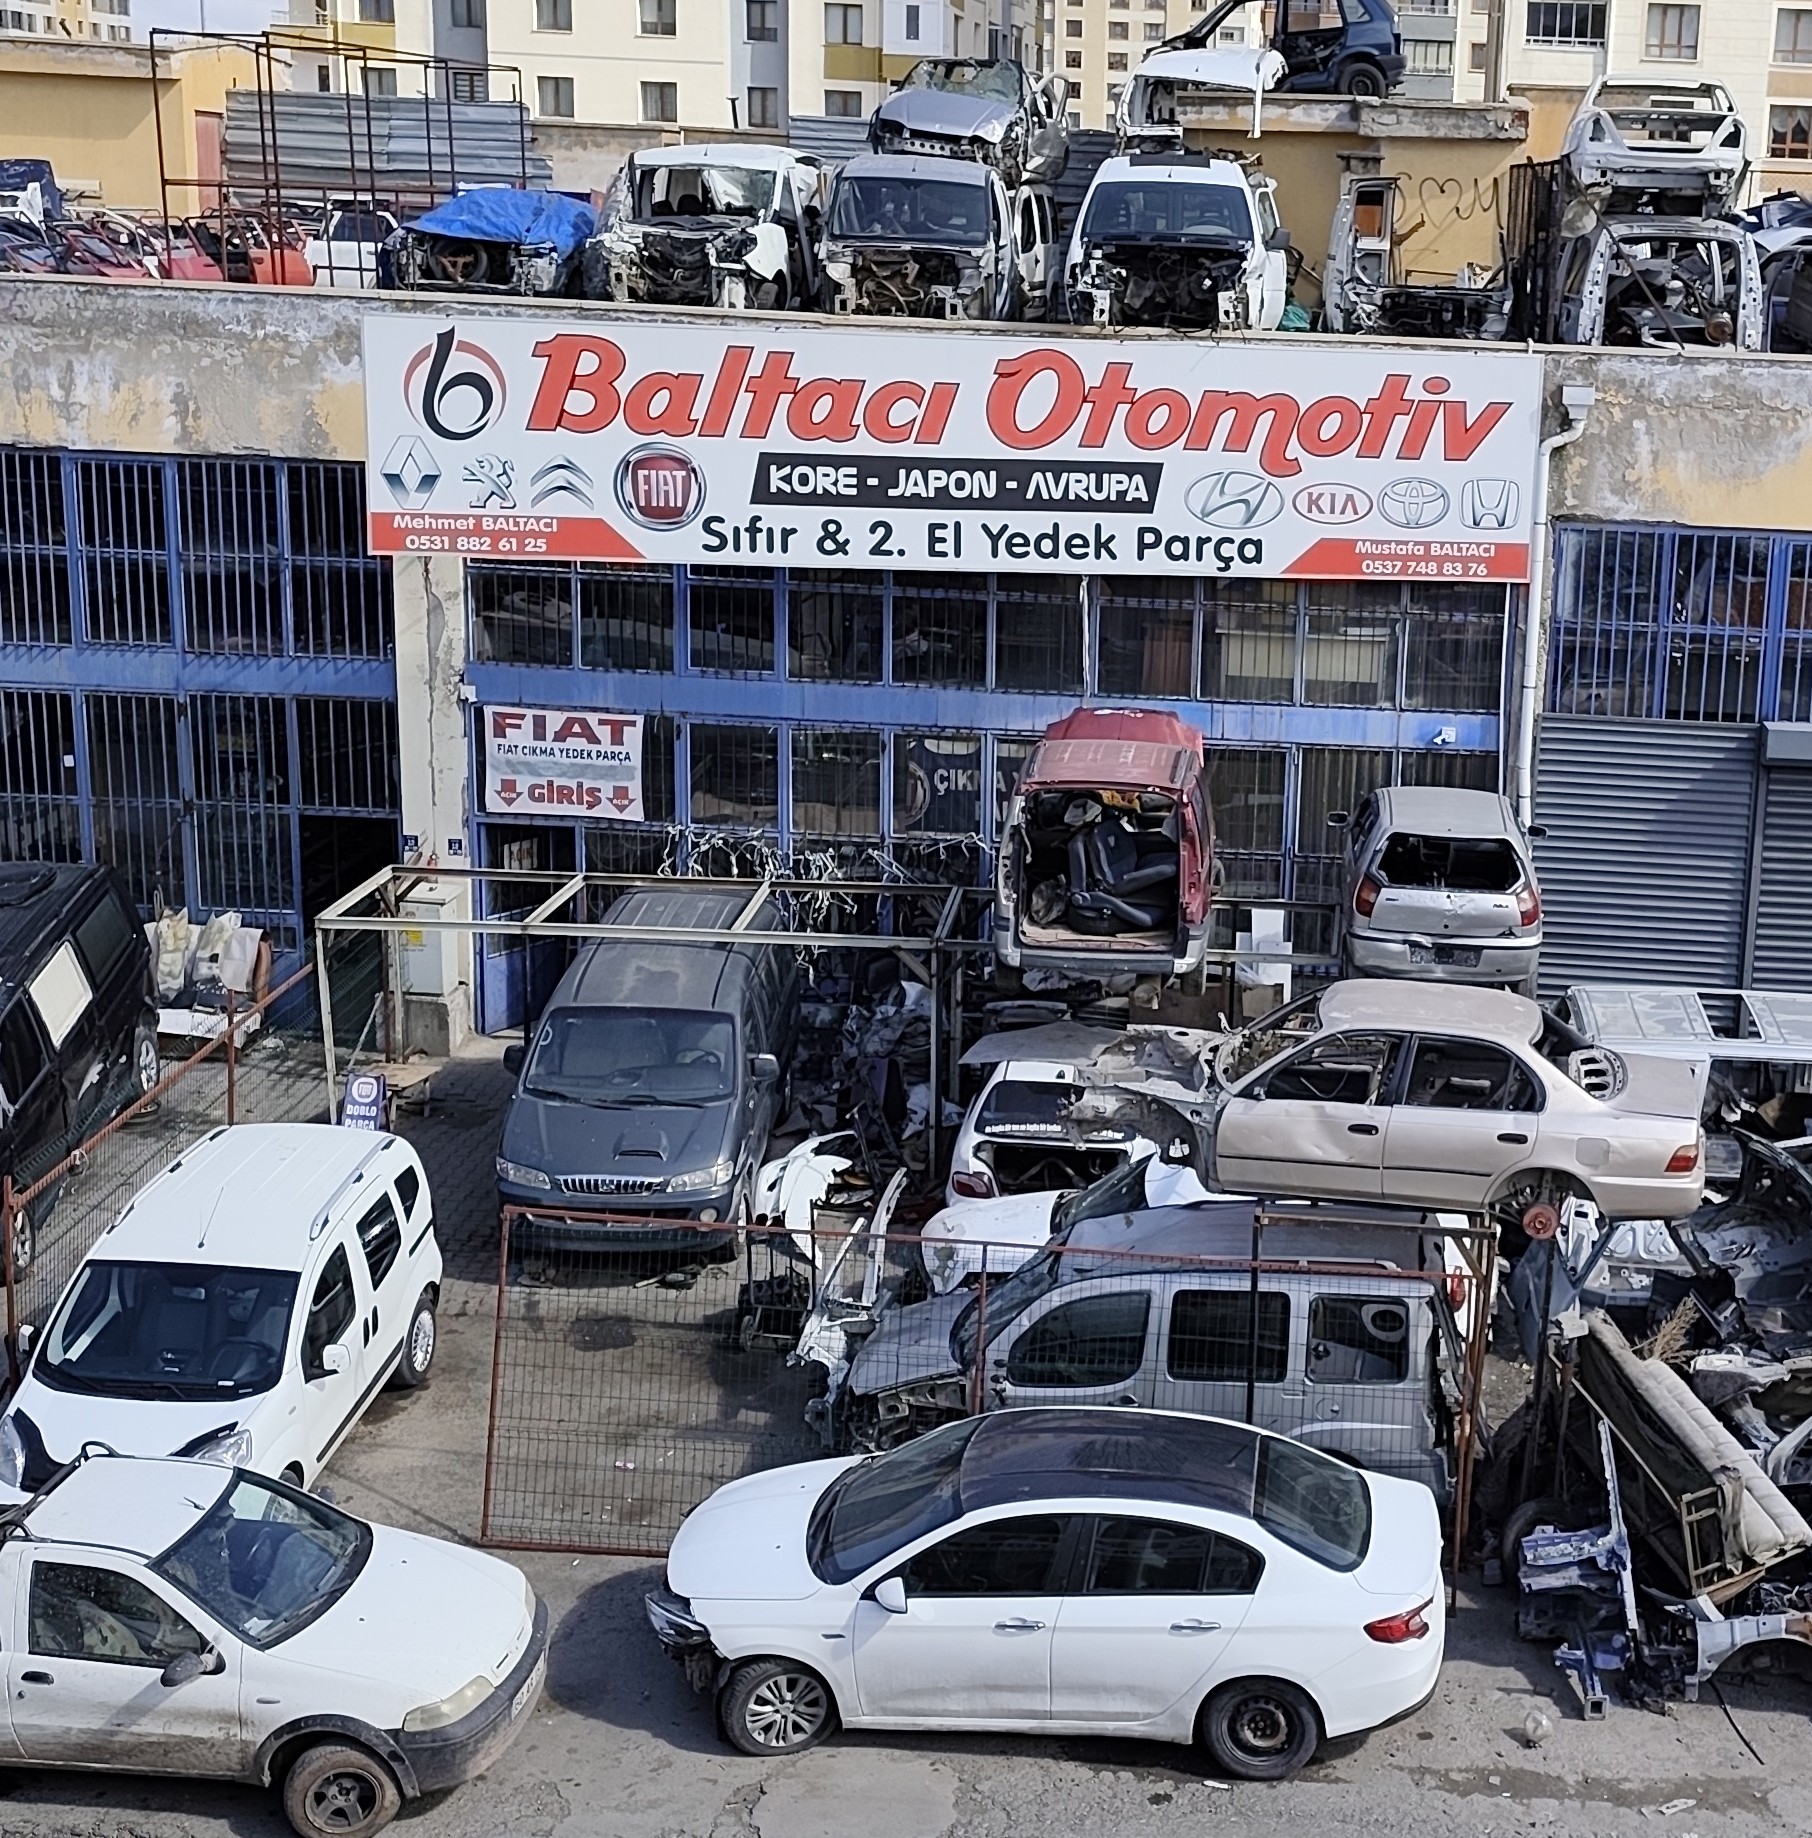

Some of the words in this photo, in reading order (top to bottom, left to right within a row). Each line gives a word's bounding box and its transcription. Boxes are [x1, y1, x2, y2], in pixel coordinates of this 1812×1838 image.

[526, 333, 960, 445] Baltacı
[986, 348, 1514, 478] Otomotiv
[637, 469, 687, 508] FIAT
[769, 464, 858, 496] KORE
[887, 468, 997, 499] JAPON
[1025, 471, 1149, 502] AVRUPA
[1306, 491, 1360, 516] KIA
[393, 515, 476, 531] Mehmet
[482, 517, 558, 533] BALTACI
[405, 535, 449, 550] 0531
[457, 536, 492, 551] 882
[498, 537, 517, 552] 61
[524, 538, 547, 552] 25
[701, 515, 798, 554] Sıfır
[816, 518, 850, 556] &
[868, 520, 905, 557] 2.
[928, 521, 961, 558] El
[981, 522, 1117, 560] Yedek
[1137, 526, 1263, 572] Parça
[1355, 541, 1424, 556] Mustafa
[1430, 543, 1495, 557] BALTACI
[1362, 560, 1402, 574] 0537
[1407, 561, 1438, 575] 748
[1443, 562, 1462, 575] 83
[1468, 563, 1487, 576] 76
[492, 711, 637, 746] FIAT
[497, 744, 519, 755] FIAT
[558, 747, 593, 760] YEDEK
[596, 750, 631, 765] PARÇA
[527, 780, 602, 810] GİRİŞ
[346, 1104, 377, 1116] DOBLO
